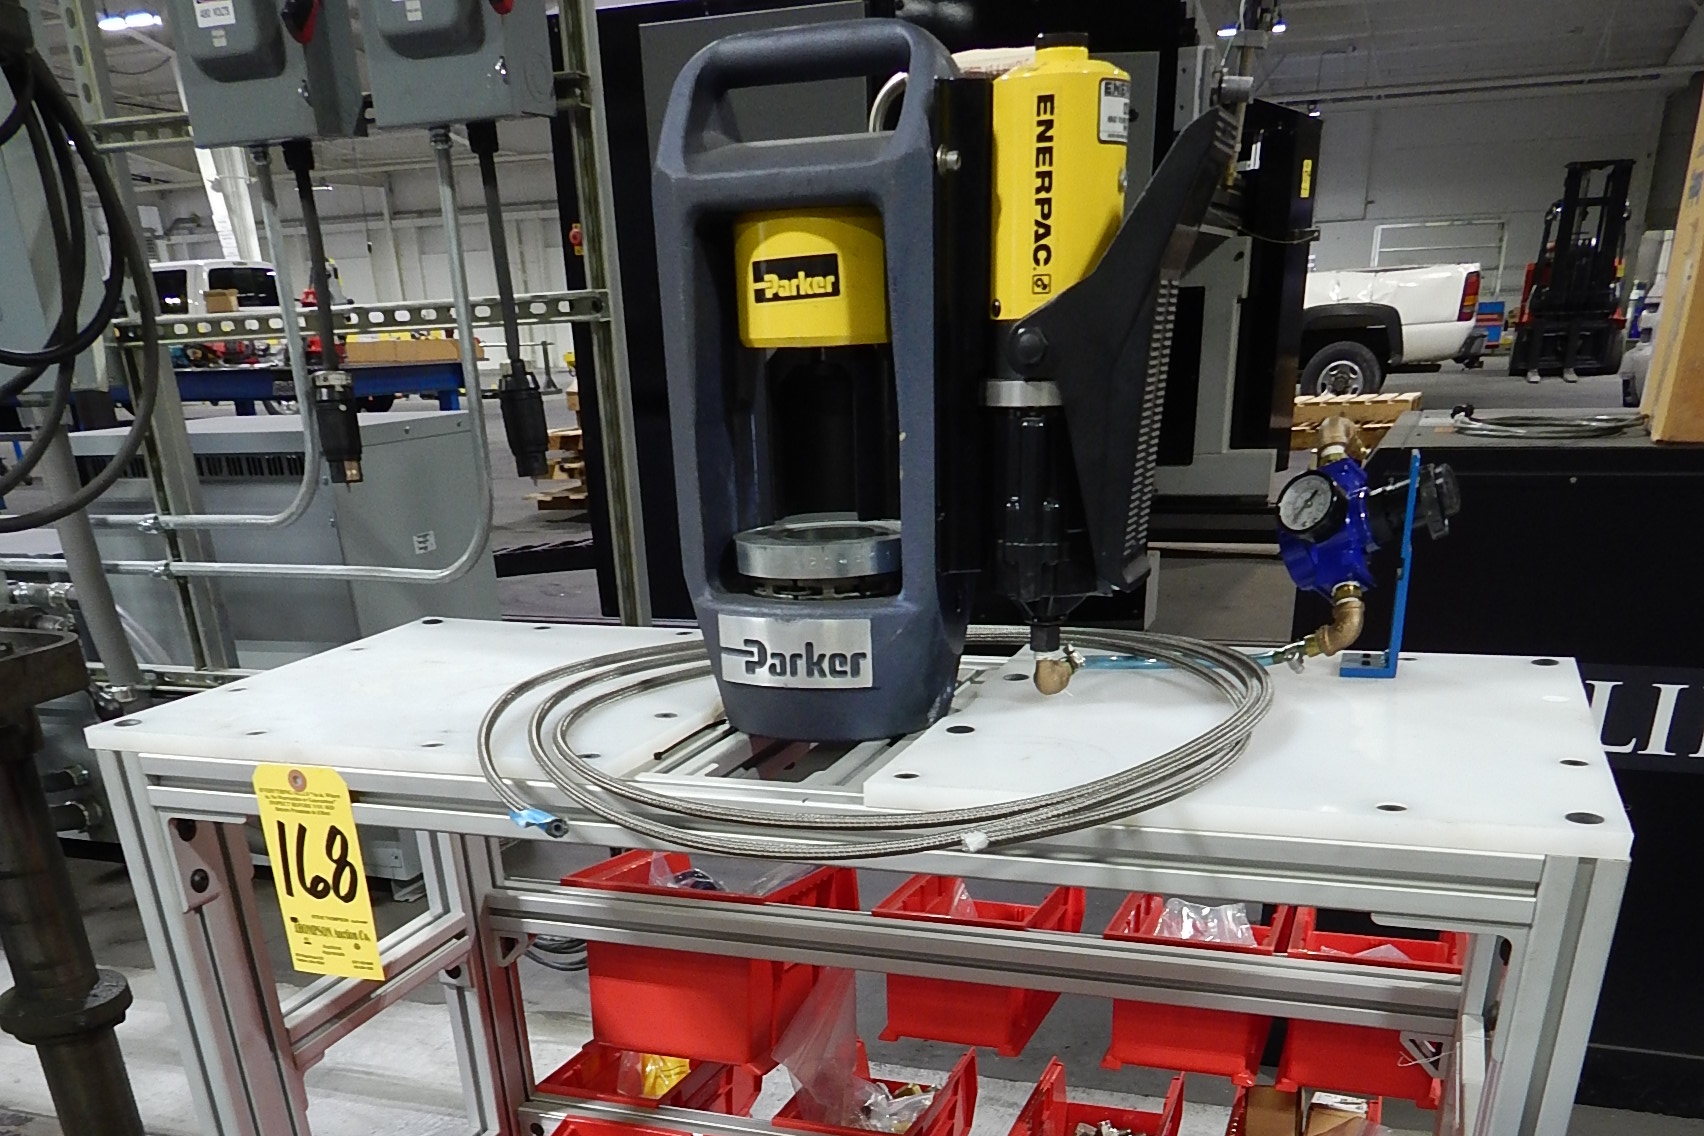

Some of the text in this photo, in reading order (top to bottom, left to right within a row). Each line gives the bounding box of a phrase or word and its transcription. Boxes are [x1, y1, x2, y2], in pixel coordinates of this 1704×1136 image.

[1033, 94, 1055, 267] ENERPAC
[759, 269, 836, 299] Parker
[738, 638, 867, 679] Parker
[1584, 680, 1704, 758] LI
[277, 820, 358, 904] 168
